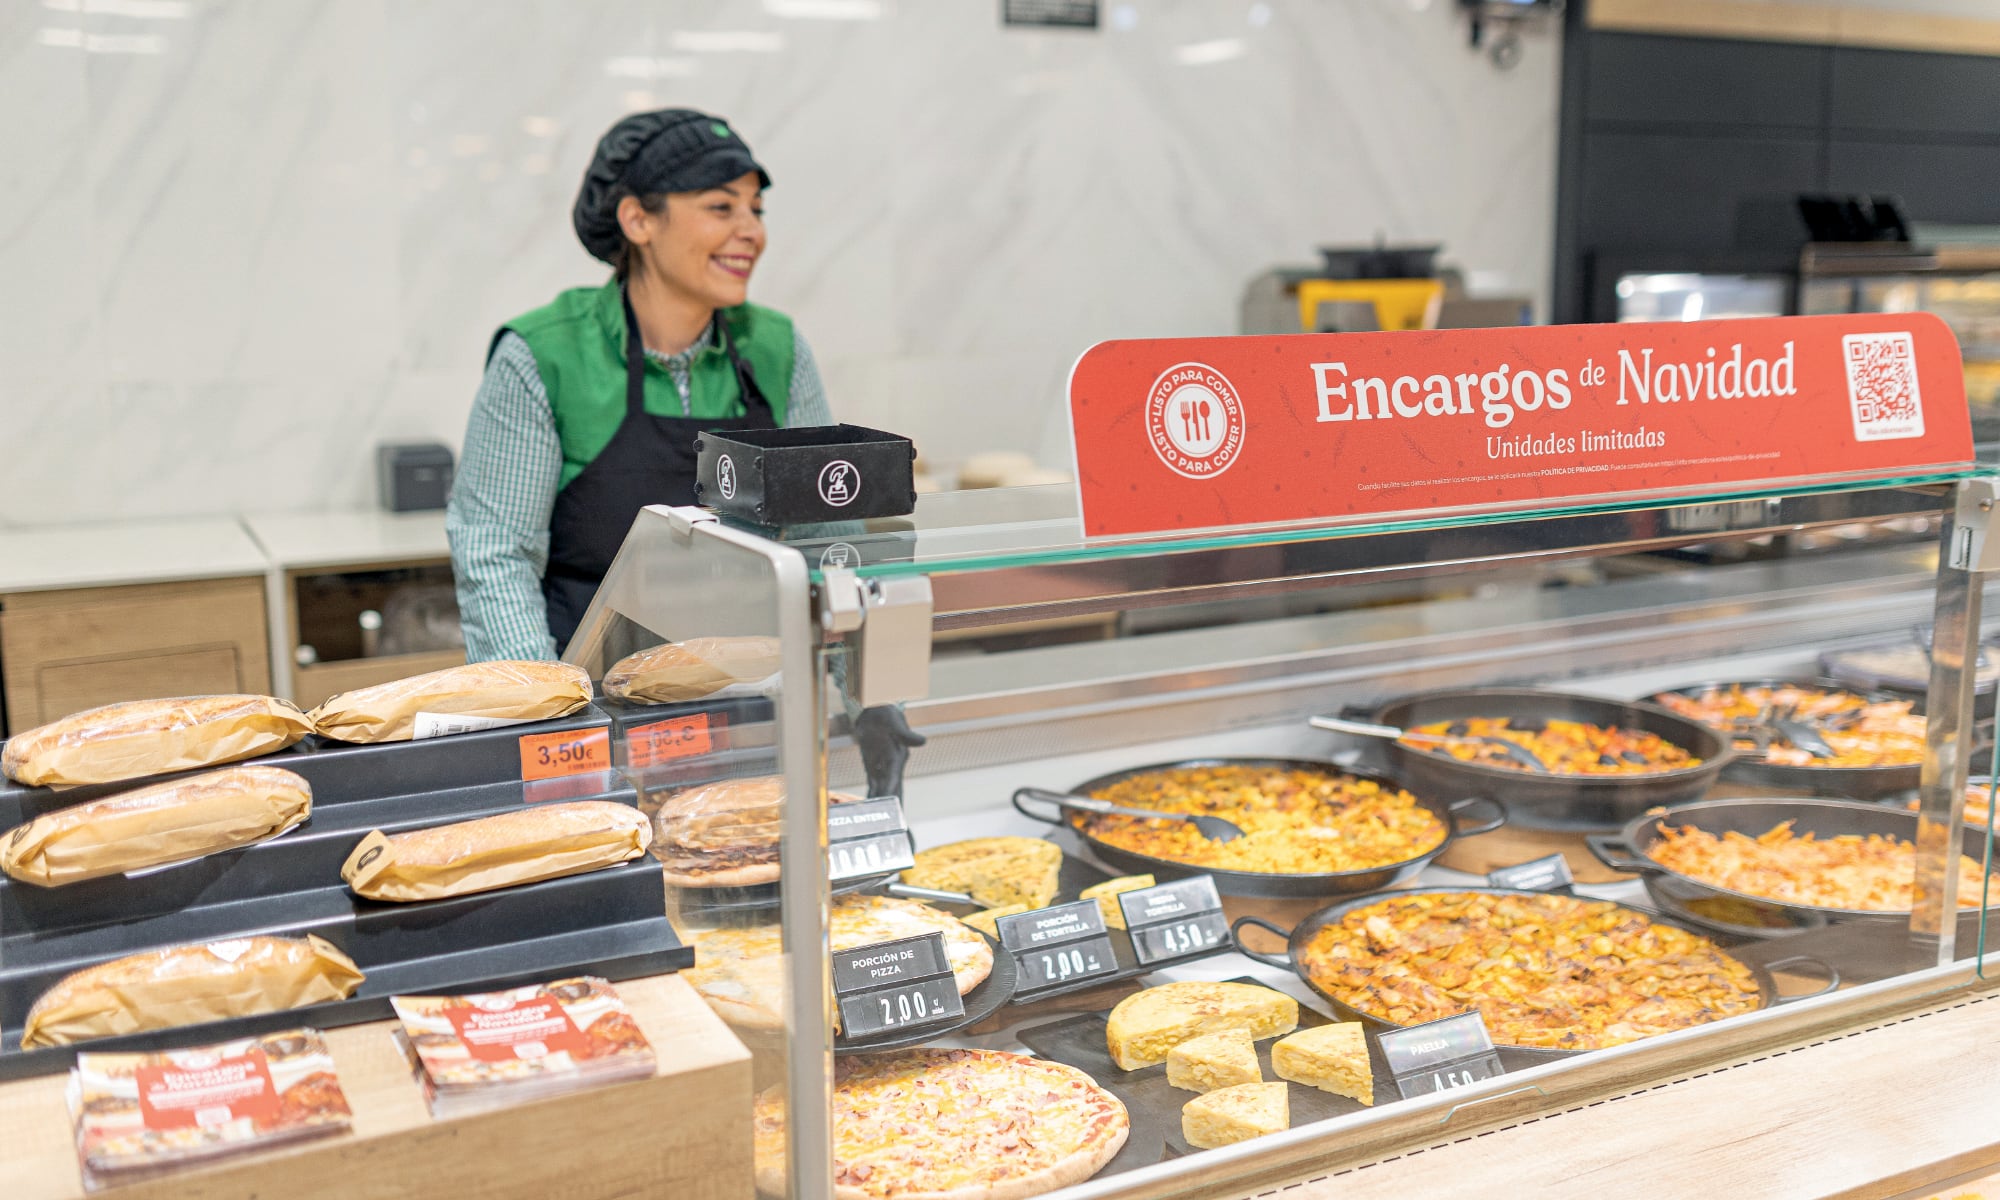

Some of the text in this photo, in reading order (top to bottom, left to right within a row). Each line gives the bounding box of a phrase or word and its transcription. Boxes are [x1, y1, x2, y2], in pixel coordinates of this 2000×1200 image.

[1152, 370, 1237, 417] LISTO PARA COMER
[1310, 341, 1798, 428] Encargos de Navidad
[1152, 424, 1240, 473] LISTO PARA COMER
[1486, 426, 1665, 459] Unidades limitadas
[1541, 467, 1567, 476] POLÍTICA
[1567, 467, 1576, 475] DE
[537, 741, 593, 768] 3,50€
[853, 812, 890, 824] ENTERA
[1036, 912, 1079, 929] PORCIÓN
[1144, 902, 1186, 918] TORTILLA
[1031, 922, 1090, 942] DE TORTILLA
[1164, 923, 1204, 953] 4,50
[851, 949, 915, 969] PORCIÓN DE
[1042, 949, 1085, 980] 2,00
[870, 965, 902, 978] PIZZA
[880, 991, 926, 1026] 2,00
[1410, 1039, 1450, 1056] PAELLA
